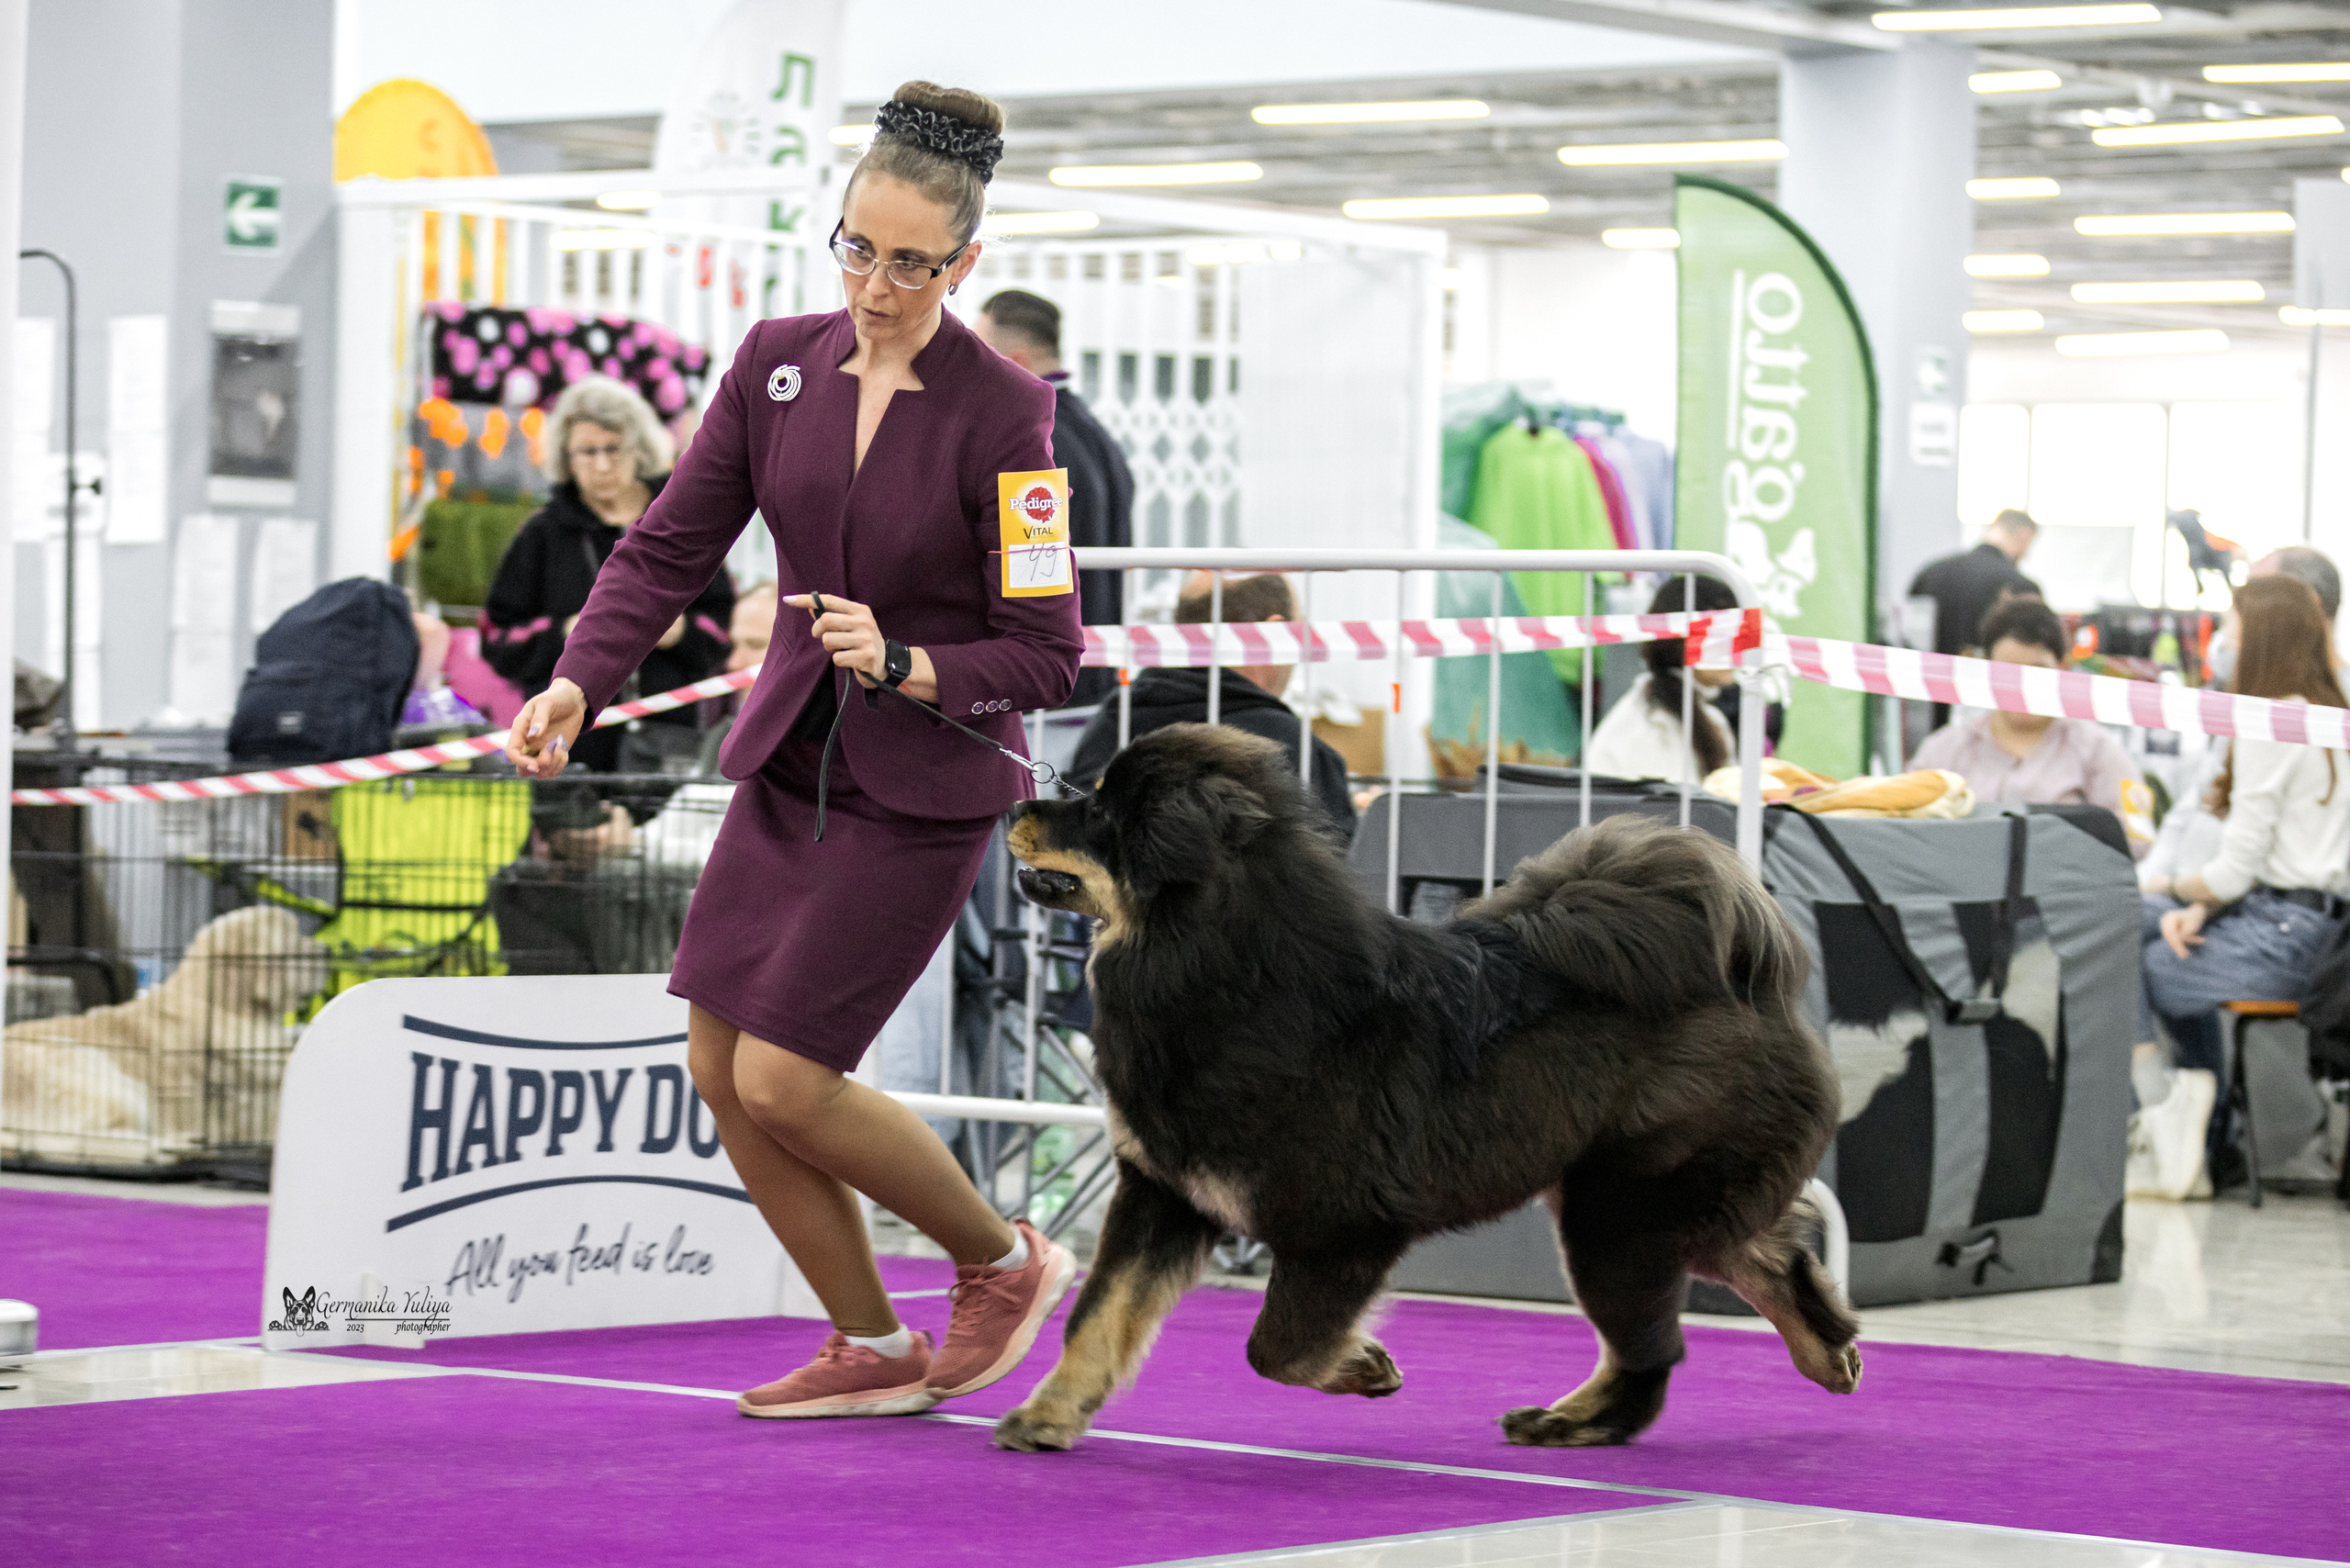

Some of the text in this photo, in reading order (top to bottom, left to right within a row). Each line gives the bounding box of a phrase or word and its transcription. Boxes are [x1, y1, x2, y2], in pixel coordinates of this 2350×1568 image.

[1009, 497, 1063, 511] Pedigree
[401, 1050, 636, 1193] HAPPY
[444, 1222, 712, 1303] All you feed is love
